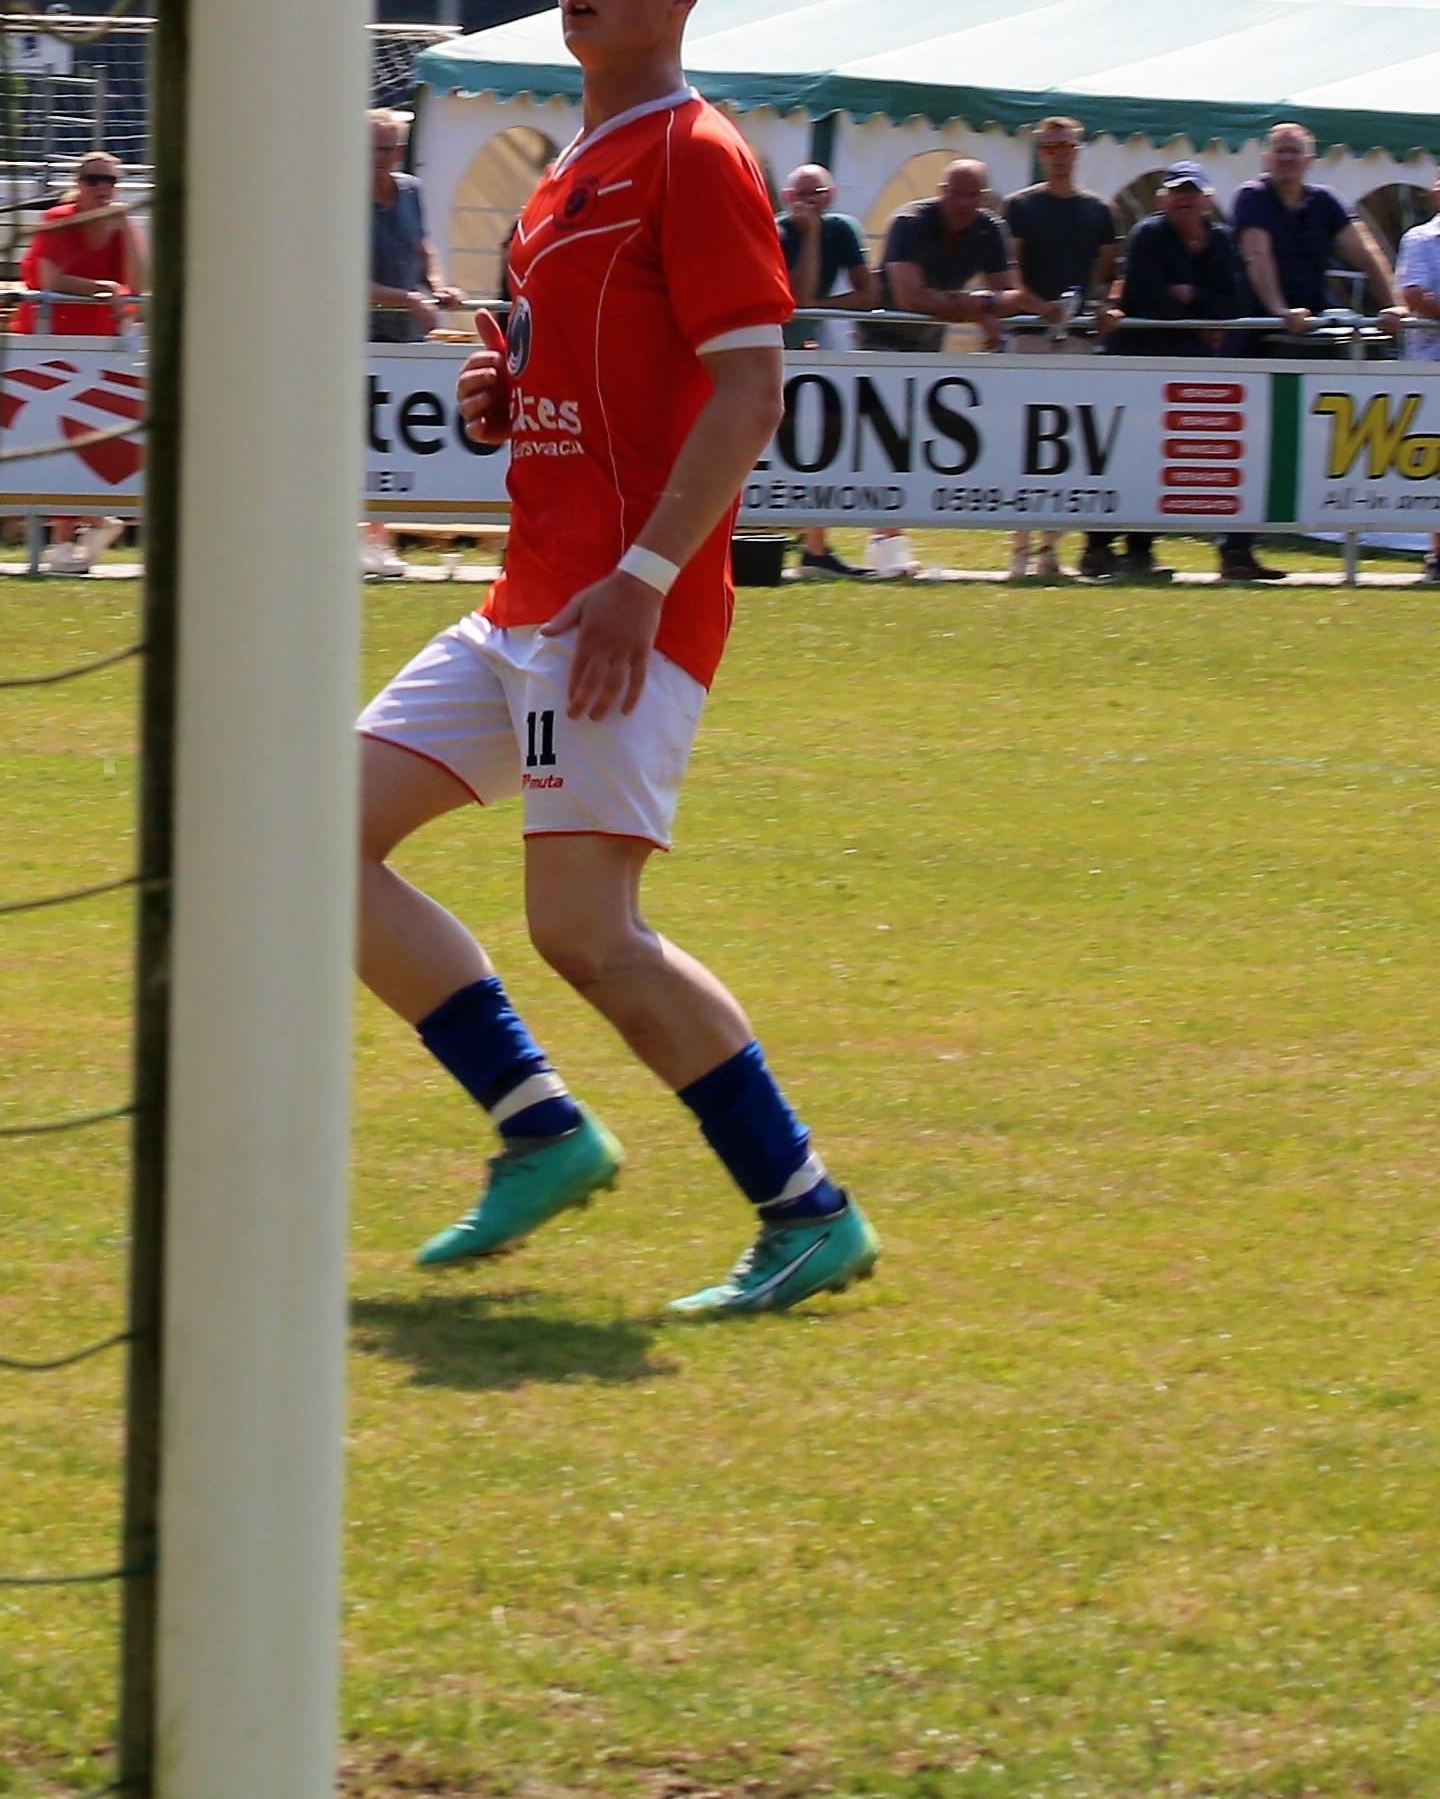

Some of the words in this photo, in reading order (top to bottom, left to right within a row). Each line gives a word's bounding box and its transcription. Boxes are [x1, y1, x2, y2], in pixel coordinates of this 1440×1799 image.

[753, 373, 981, 476] ONS
[1022, 403, 1126, 477] BV
[526, 710, 557, 767] 11
